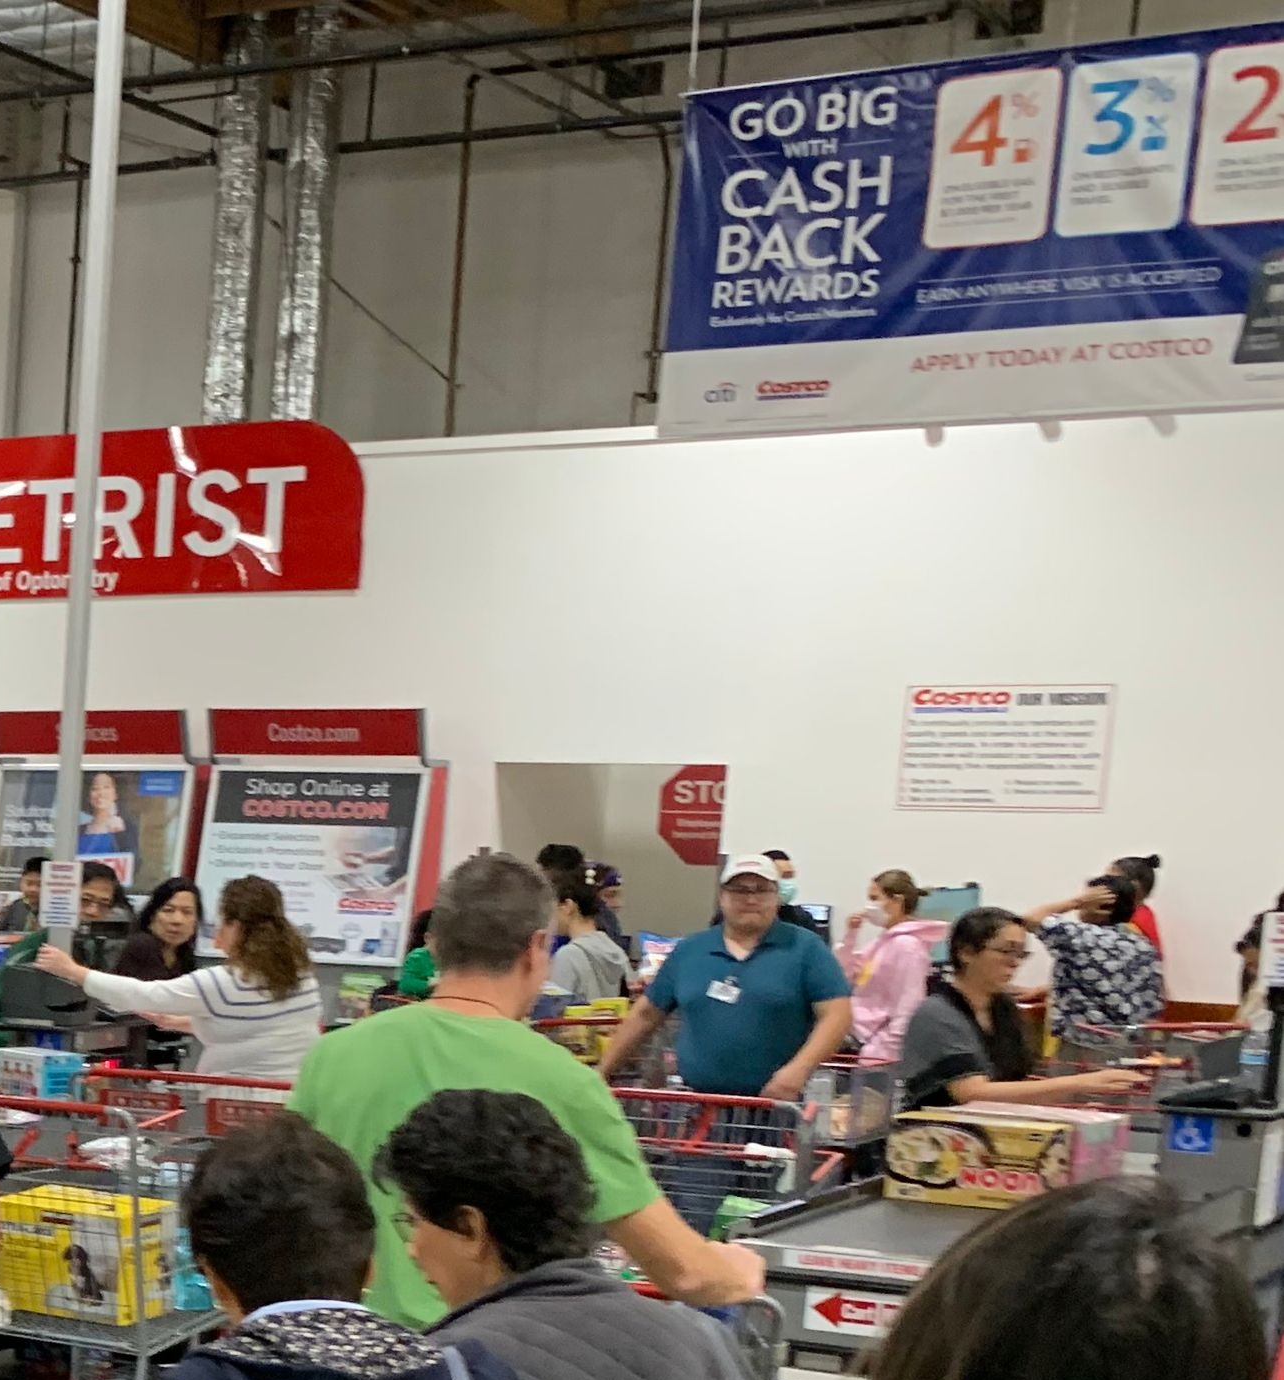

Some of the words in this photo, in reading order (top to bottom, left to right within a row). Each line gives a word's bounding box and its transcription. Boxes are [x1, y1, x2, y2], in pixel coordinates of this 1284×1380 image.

[729, 98, 807, 141] GO
[816, 86, 899, 132] BIG
[782, 138, 839, 158] WITH
[721, 155, 893, 218] CASH
[715, 213, 888, 275] BACK
[711, 268, 881, 309] REWARDS
[910, 350, 976, 373] APPLY
[986, 345, 1068, 367] TODAY
[1070, 344, 1104, 362] AT
[1108, 336, 1213, 360] COSTCO
[267, 723, 361, 743] Costco.com
[244, 778, 297, 798] Shop
[300, 778, 365, 797] Online
[368, 780, 391, 798] at
[241, 799, 390, 821] COSTCO.COM
